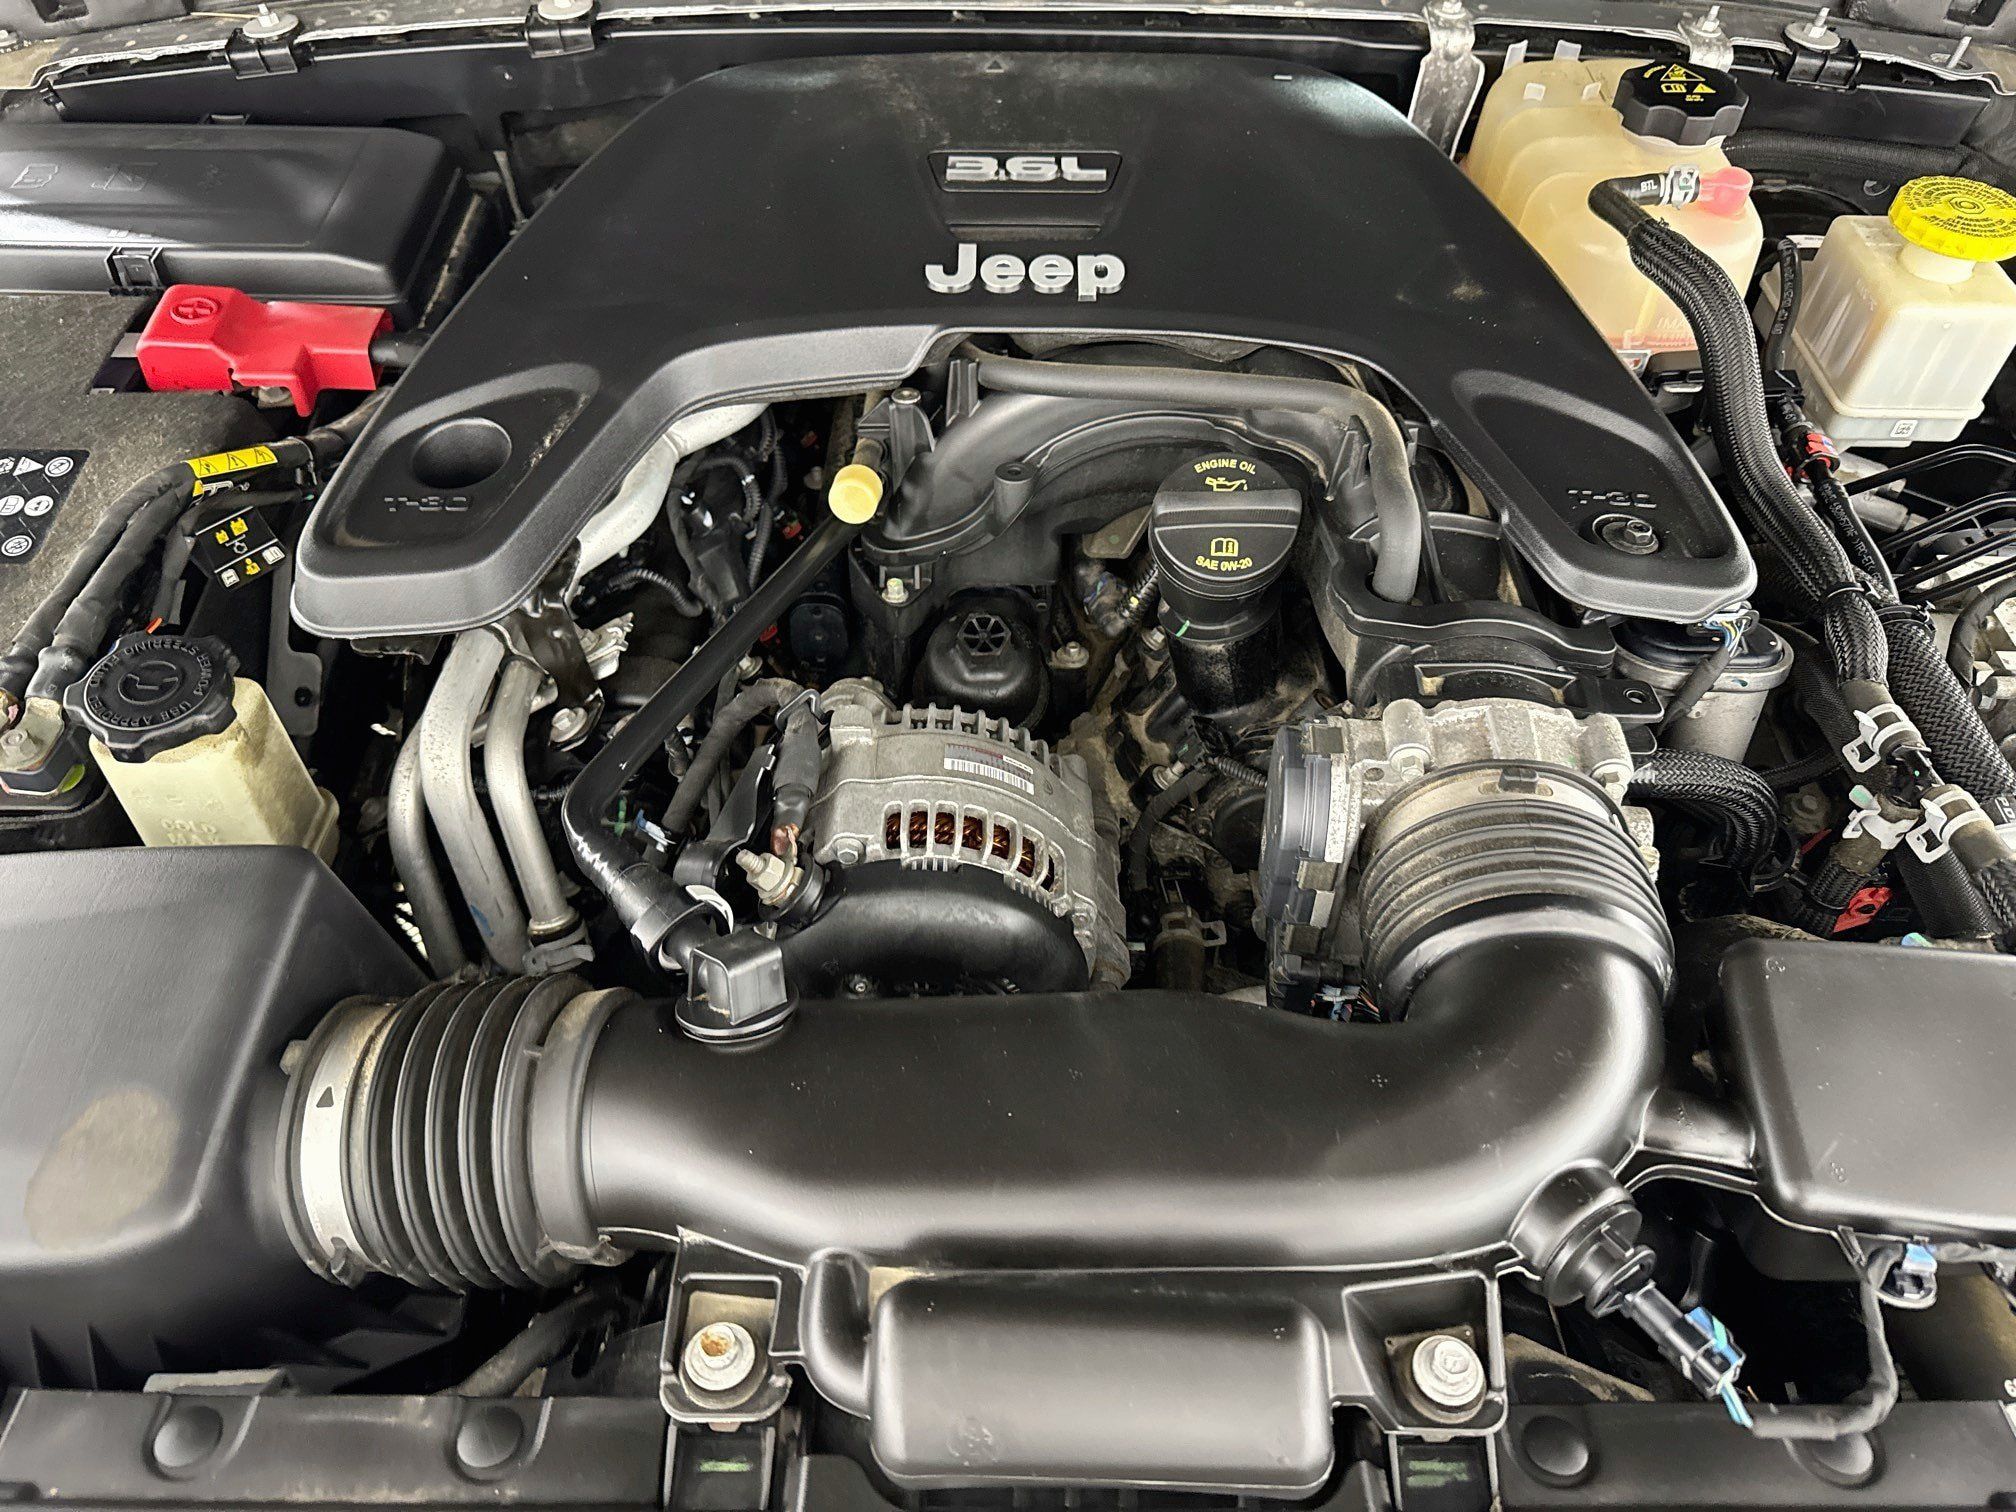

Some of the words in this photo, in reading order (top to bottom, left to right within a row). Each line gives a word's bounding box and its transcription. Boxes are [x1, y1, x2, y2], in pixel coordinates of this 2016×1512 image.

[945, 155, 1107, 182] 3.6L
[1640, 179, 1658, 193] BTL
[925, 242, 1126, 302] Jeep
[1193, 458, 1238, 474] ENGINE
[1239, 461, 1256, 475] OIL
[1195, 555, 1219, 571] SAE
[1220, 557, 1253, 572] 0W-20
